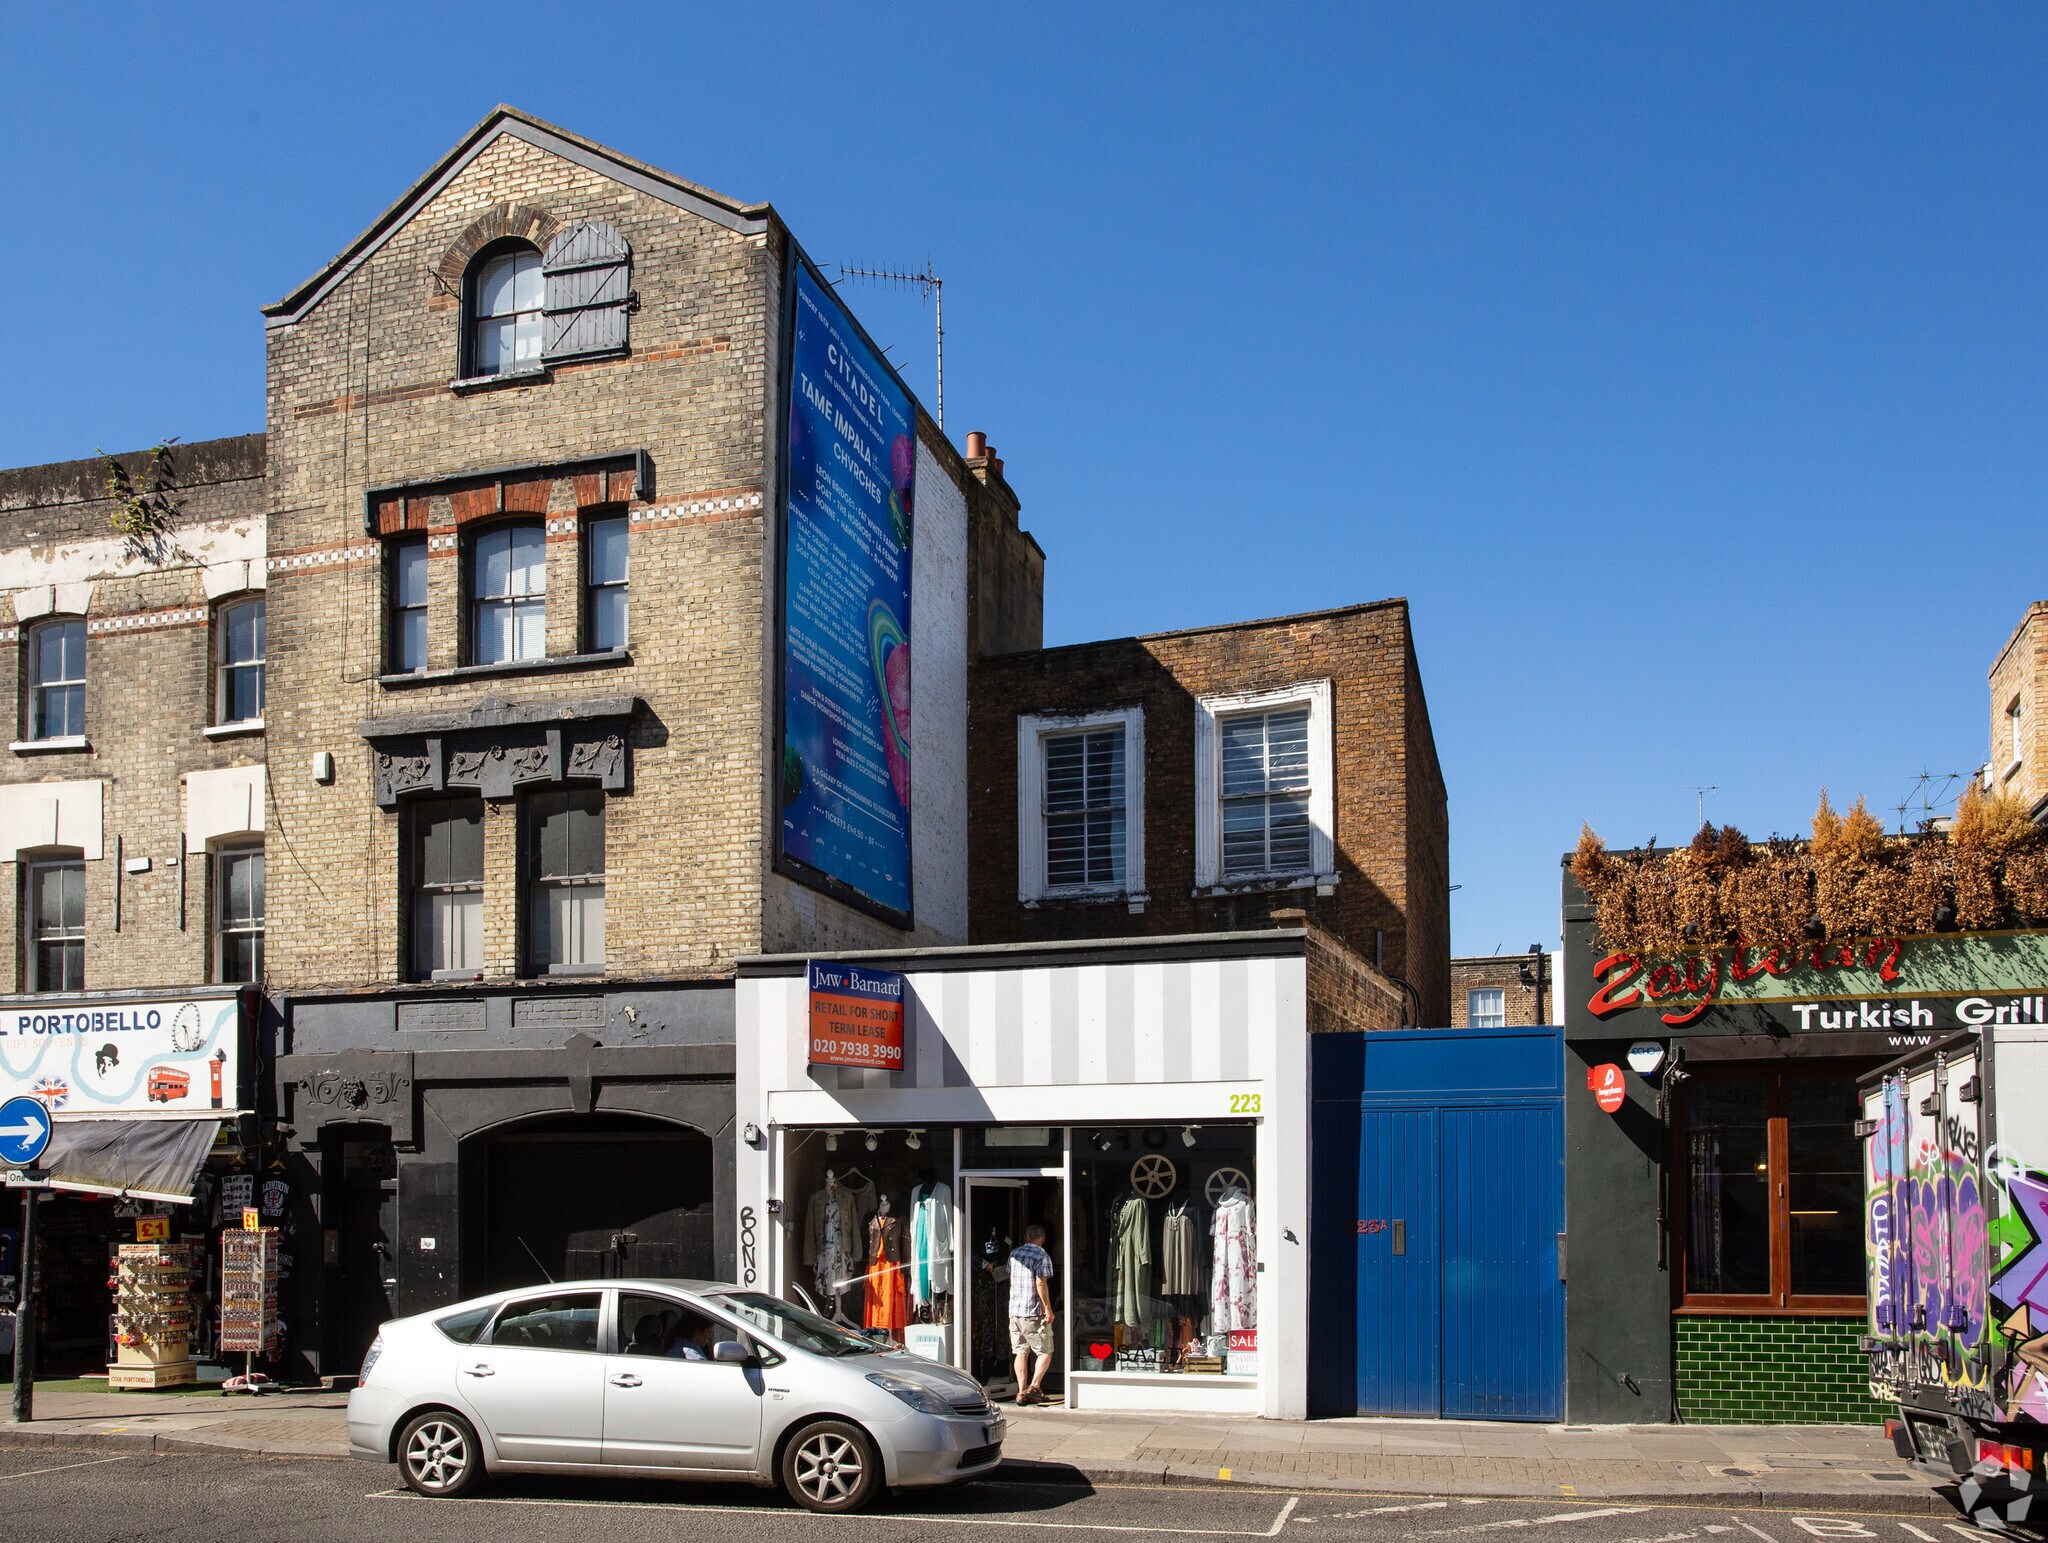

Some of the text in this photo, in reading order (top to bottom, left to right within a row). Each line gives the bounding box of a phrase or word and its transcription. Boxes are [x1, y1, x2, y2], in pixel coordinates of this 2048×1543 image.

[827, 343, 883, 426] CITADEL
[800, 372, 871, 466] TAME IMPALA
[816, 463, 830, 485] LEON
[833, 440, 881, 504] CHVRCHES
[815, 479, 831, 501] GOAT
[850, 972, 901, 996] Barnard
[815, 1001, 899, 1022] RETAIL FOR SHORT
[1792, 997, 2043, 1030] Turkish Grill
[19, 1010, 161, 1036] PORTOBELLO
[829, 1022, 886, 1038] TERM LEASE
[813, 1039, 901, 1060] 020 7938 3990
[1230, 1094, 1261, 1113] 223
[10, 1173, 26, 1182] One
[262, 1180, 289, 1195] LONDON
[141, 1222, 164, 1238] £1
